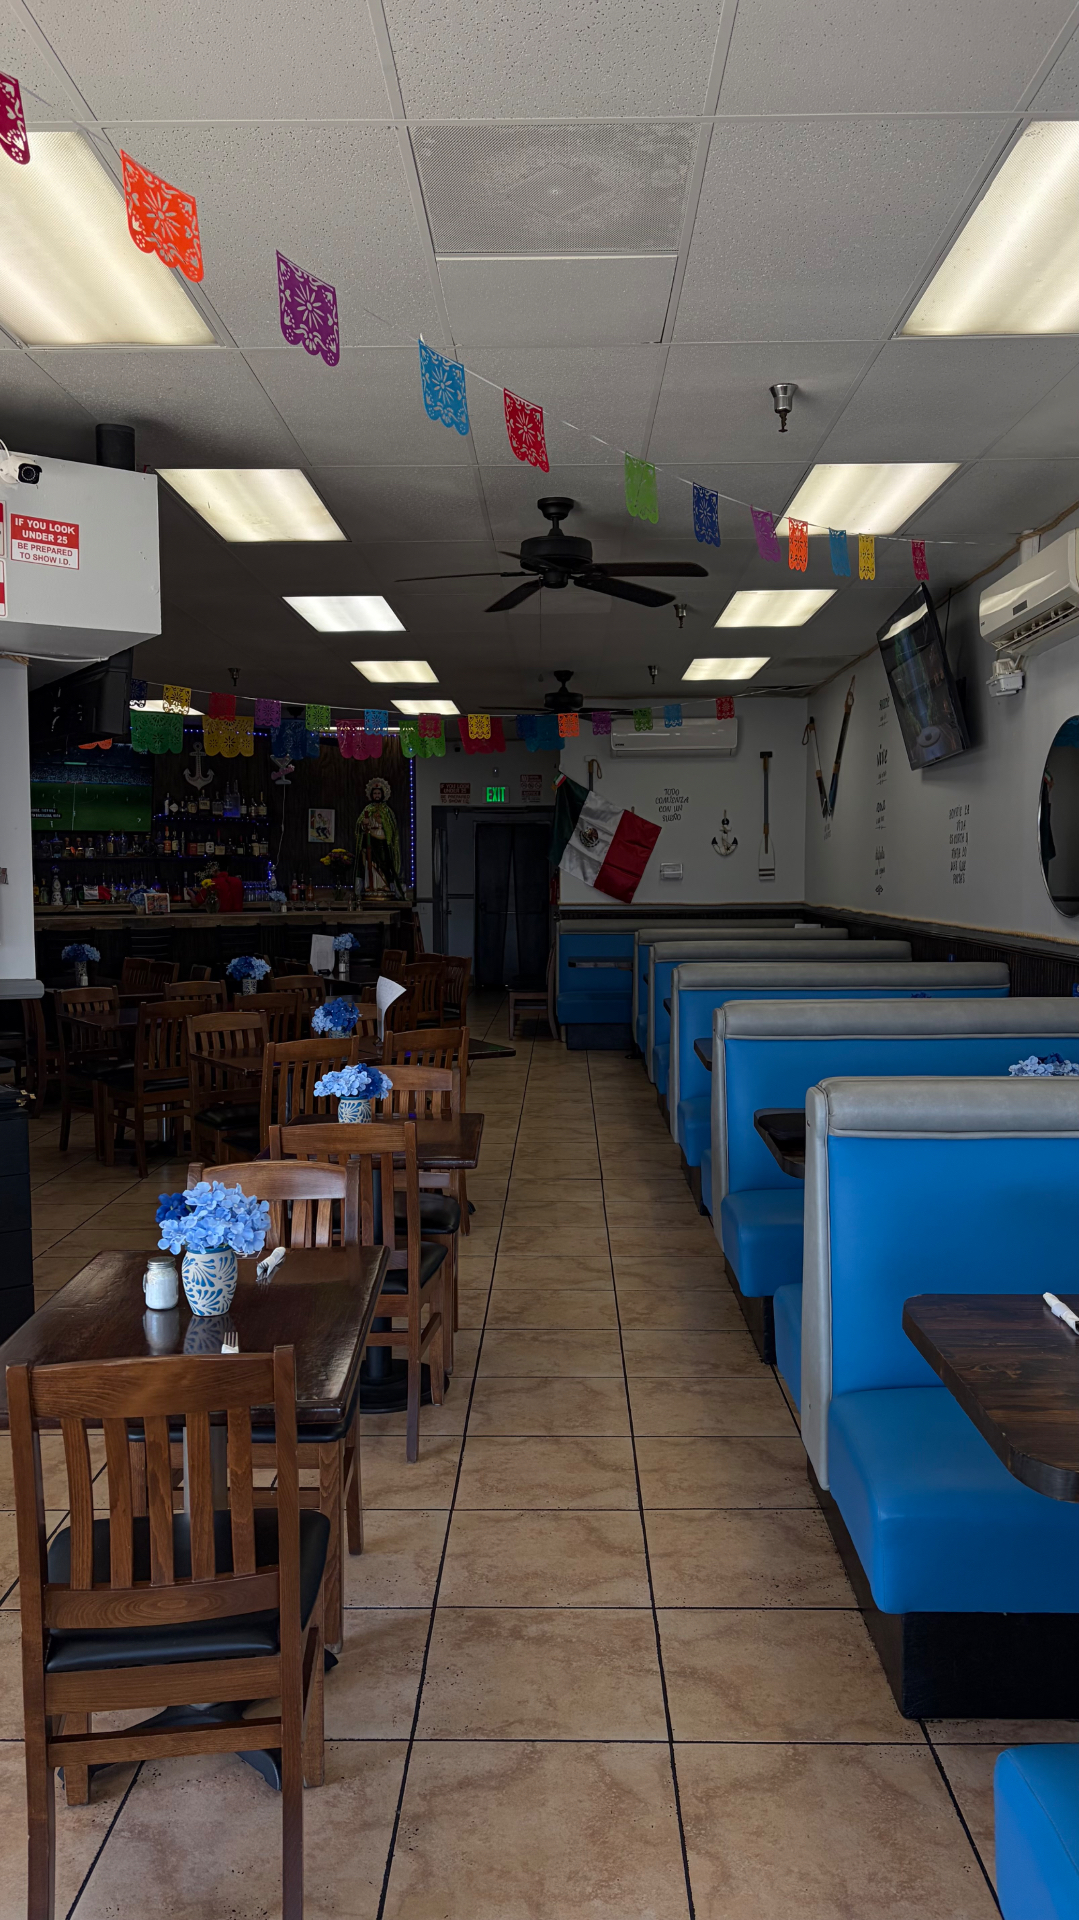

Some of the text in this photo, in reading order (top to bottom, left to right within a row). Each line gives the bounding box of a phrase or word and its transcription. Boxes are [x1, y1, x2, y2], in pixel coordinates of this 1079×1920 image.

[15, 517, 75, 535] IF YOU LOOK
[22, 530, 68, 544] UNDER 25
[17, 542, 73, 557] BE PREPARED
[19, 551, 71, 566] TO SHOW I.D.
[486, 787, 506, 803] EXIT
[664, 788, 680, 796] TODO
[673, 804, 683, 812] UN
